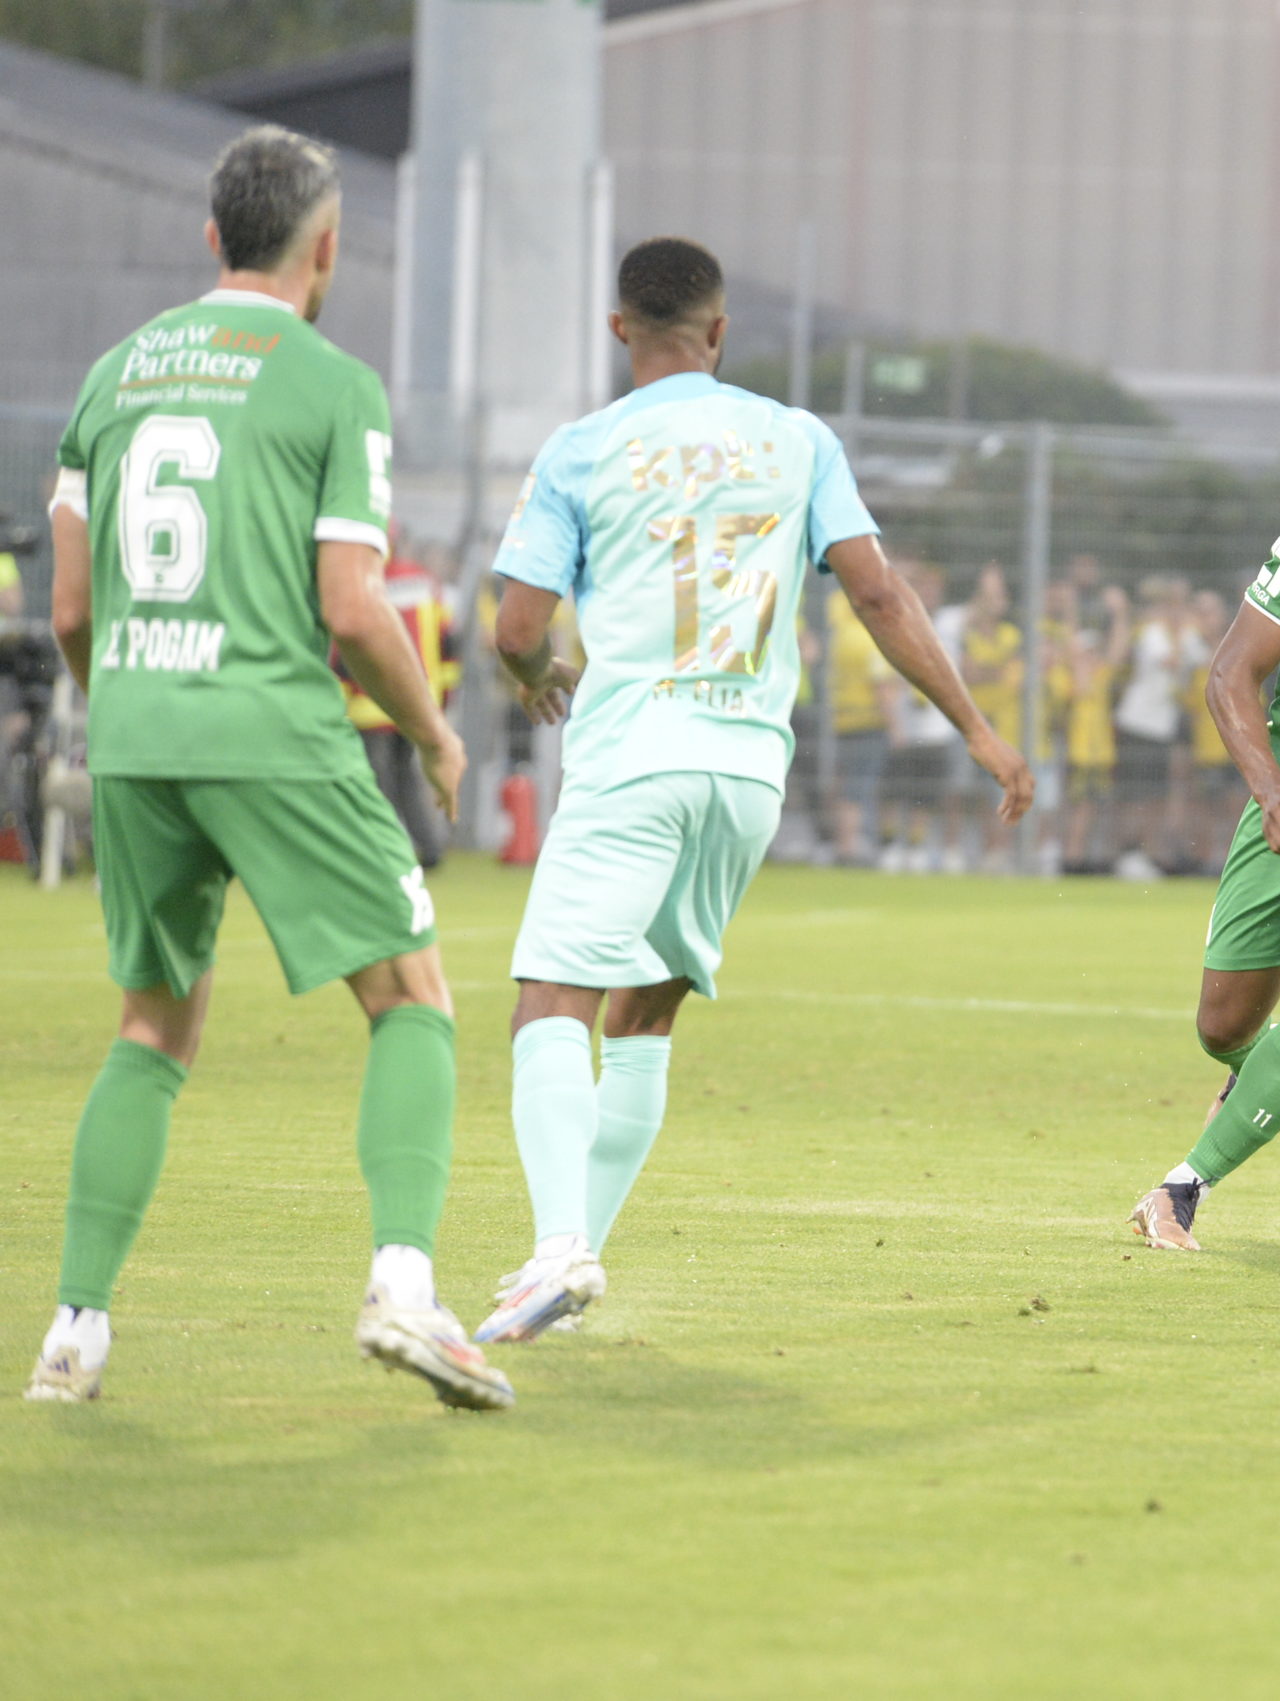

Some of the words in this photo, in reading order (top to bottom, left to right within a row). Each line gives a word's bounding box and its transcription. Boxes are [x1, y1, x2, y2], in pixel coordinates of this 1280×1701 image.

[119, 348, 262, 386] Partners
[115, 383, 185, 412] Financial
[187, 385, 248, 405] Services
[118, 415, 221, 603] 6
[646, 512, 780, 676] 15
[125, 616, 225, 674] POGAM
[1252, 1108, 1273, 1128] 11
